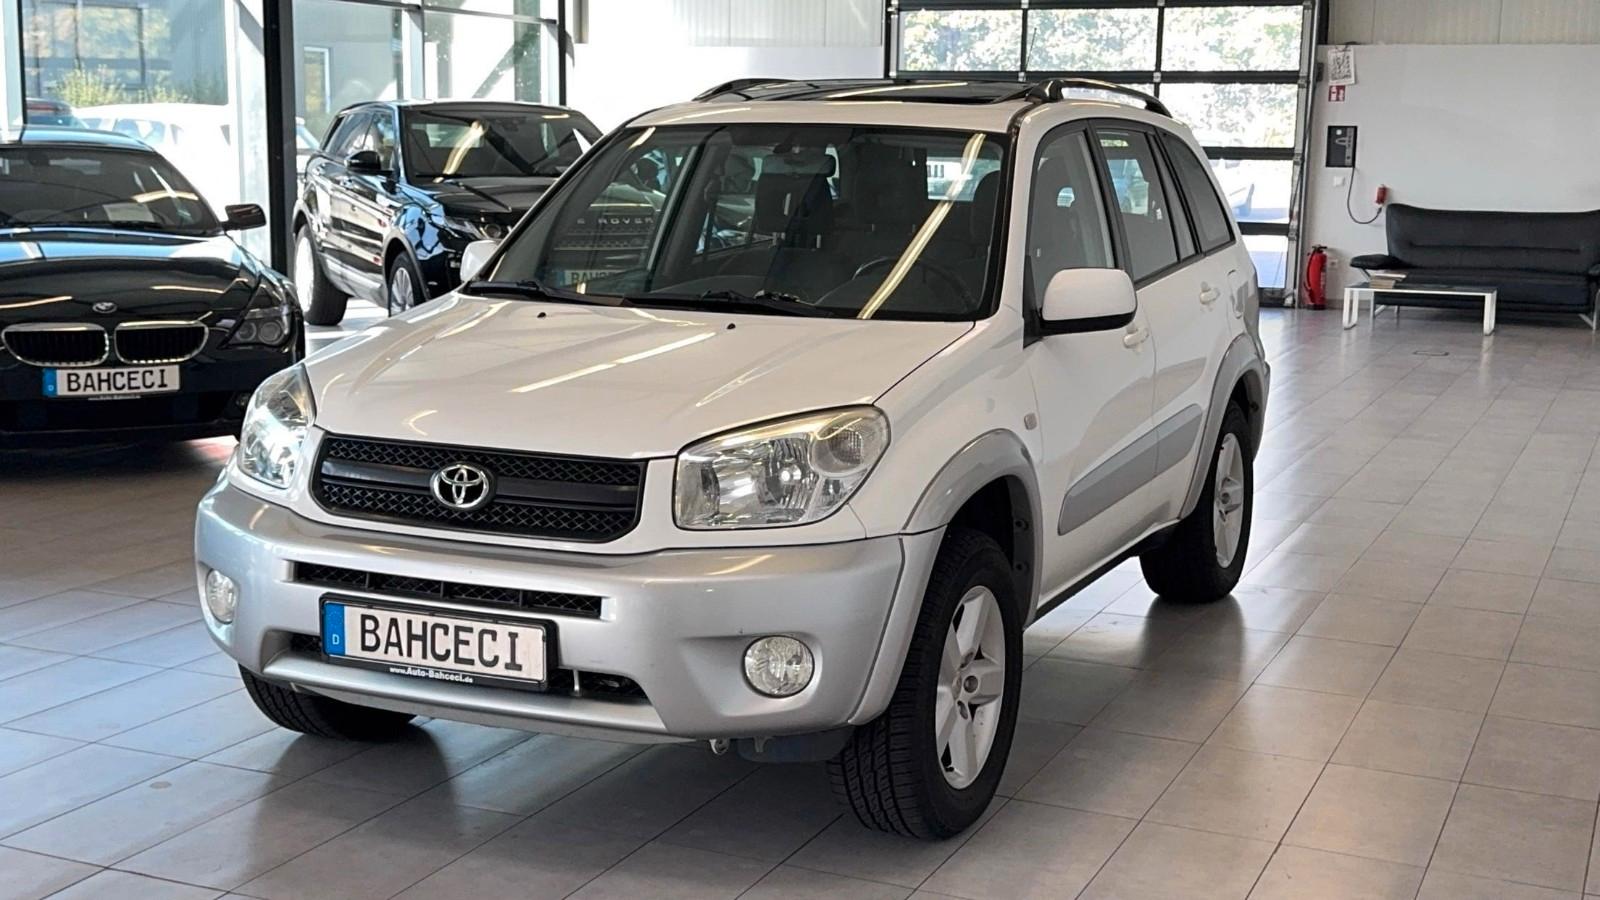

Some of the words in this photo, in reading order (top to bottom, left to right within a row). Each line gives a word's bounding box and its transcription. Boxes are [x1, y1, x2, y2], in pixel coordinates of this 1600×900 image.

[66, 369, 168, 392] BAHCECI
[332, 633, 340, 645] D
[360, 614, 523, 671] BAHCECI
[389, 667, 474, 683] www.Auto-Bahceci.de
